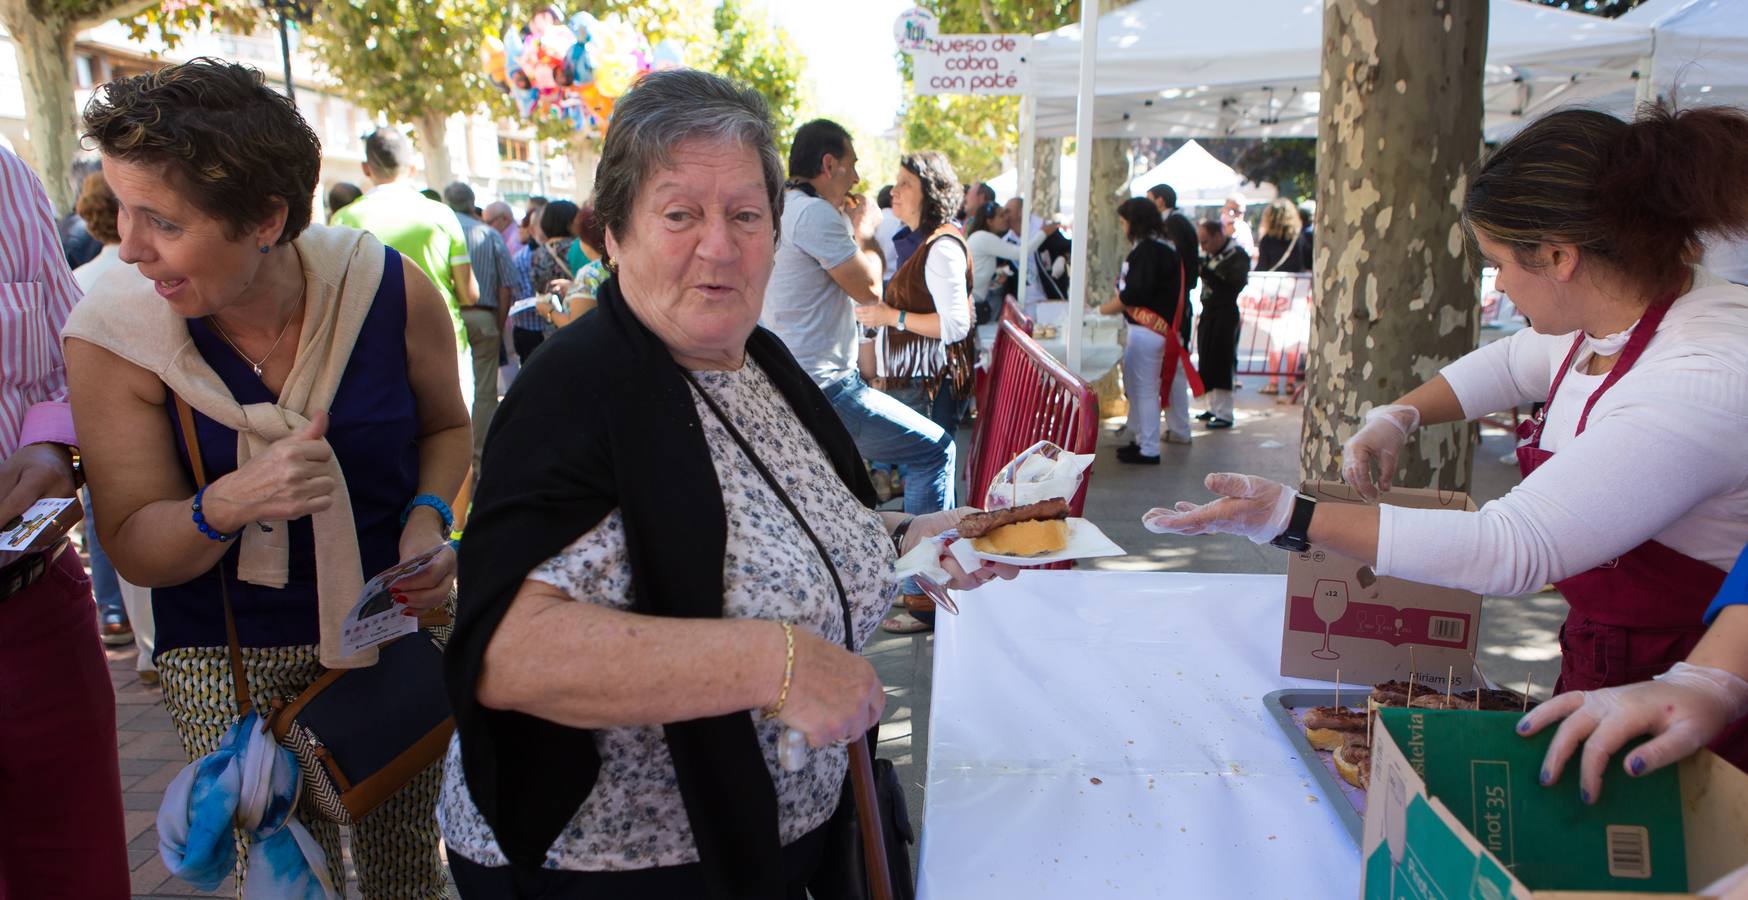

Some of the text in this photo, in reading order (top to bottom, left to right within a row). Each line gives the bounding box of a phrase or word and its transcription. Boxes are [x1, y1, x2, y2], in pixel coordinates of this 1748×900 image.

[929, 38, 987, 55] queso
[992, 36, 1016, 51] de
[945, 55, 998, 70] cabra
[930, 70, 1017, 92] con paté
[1485, 785, 1504, 809] 35
